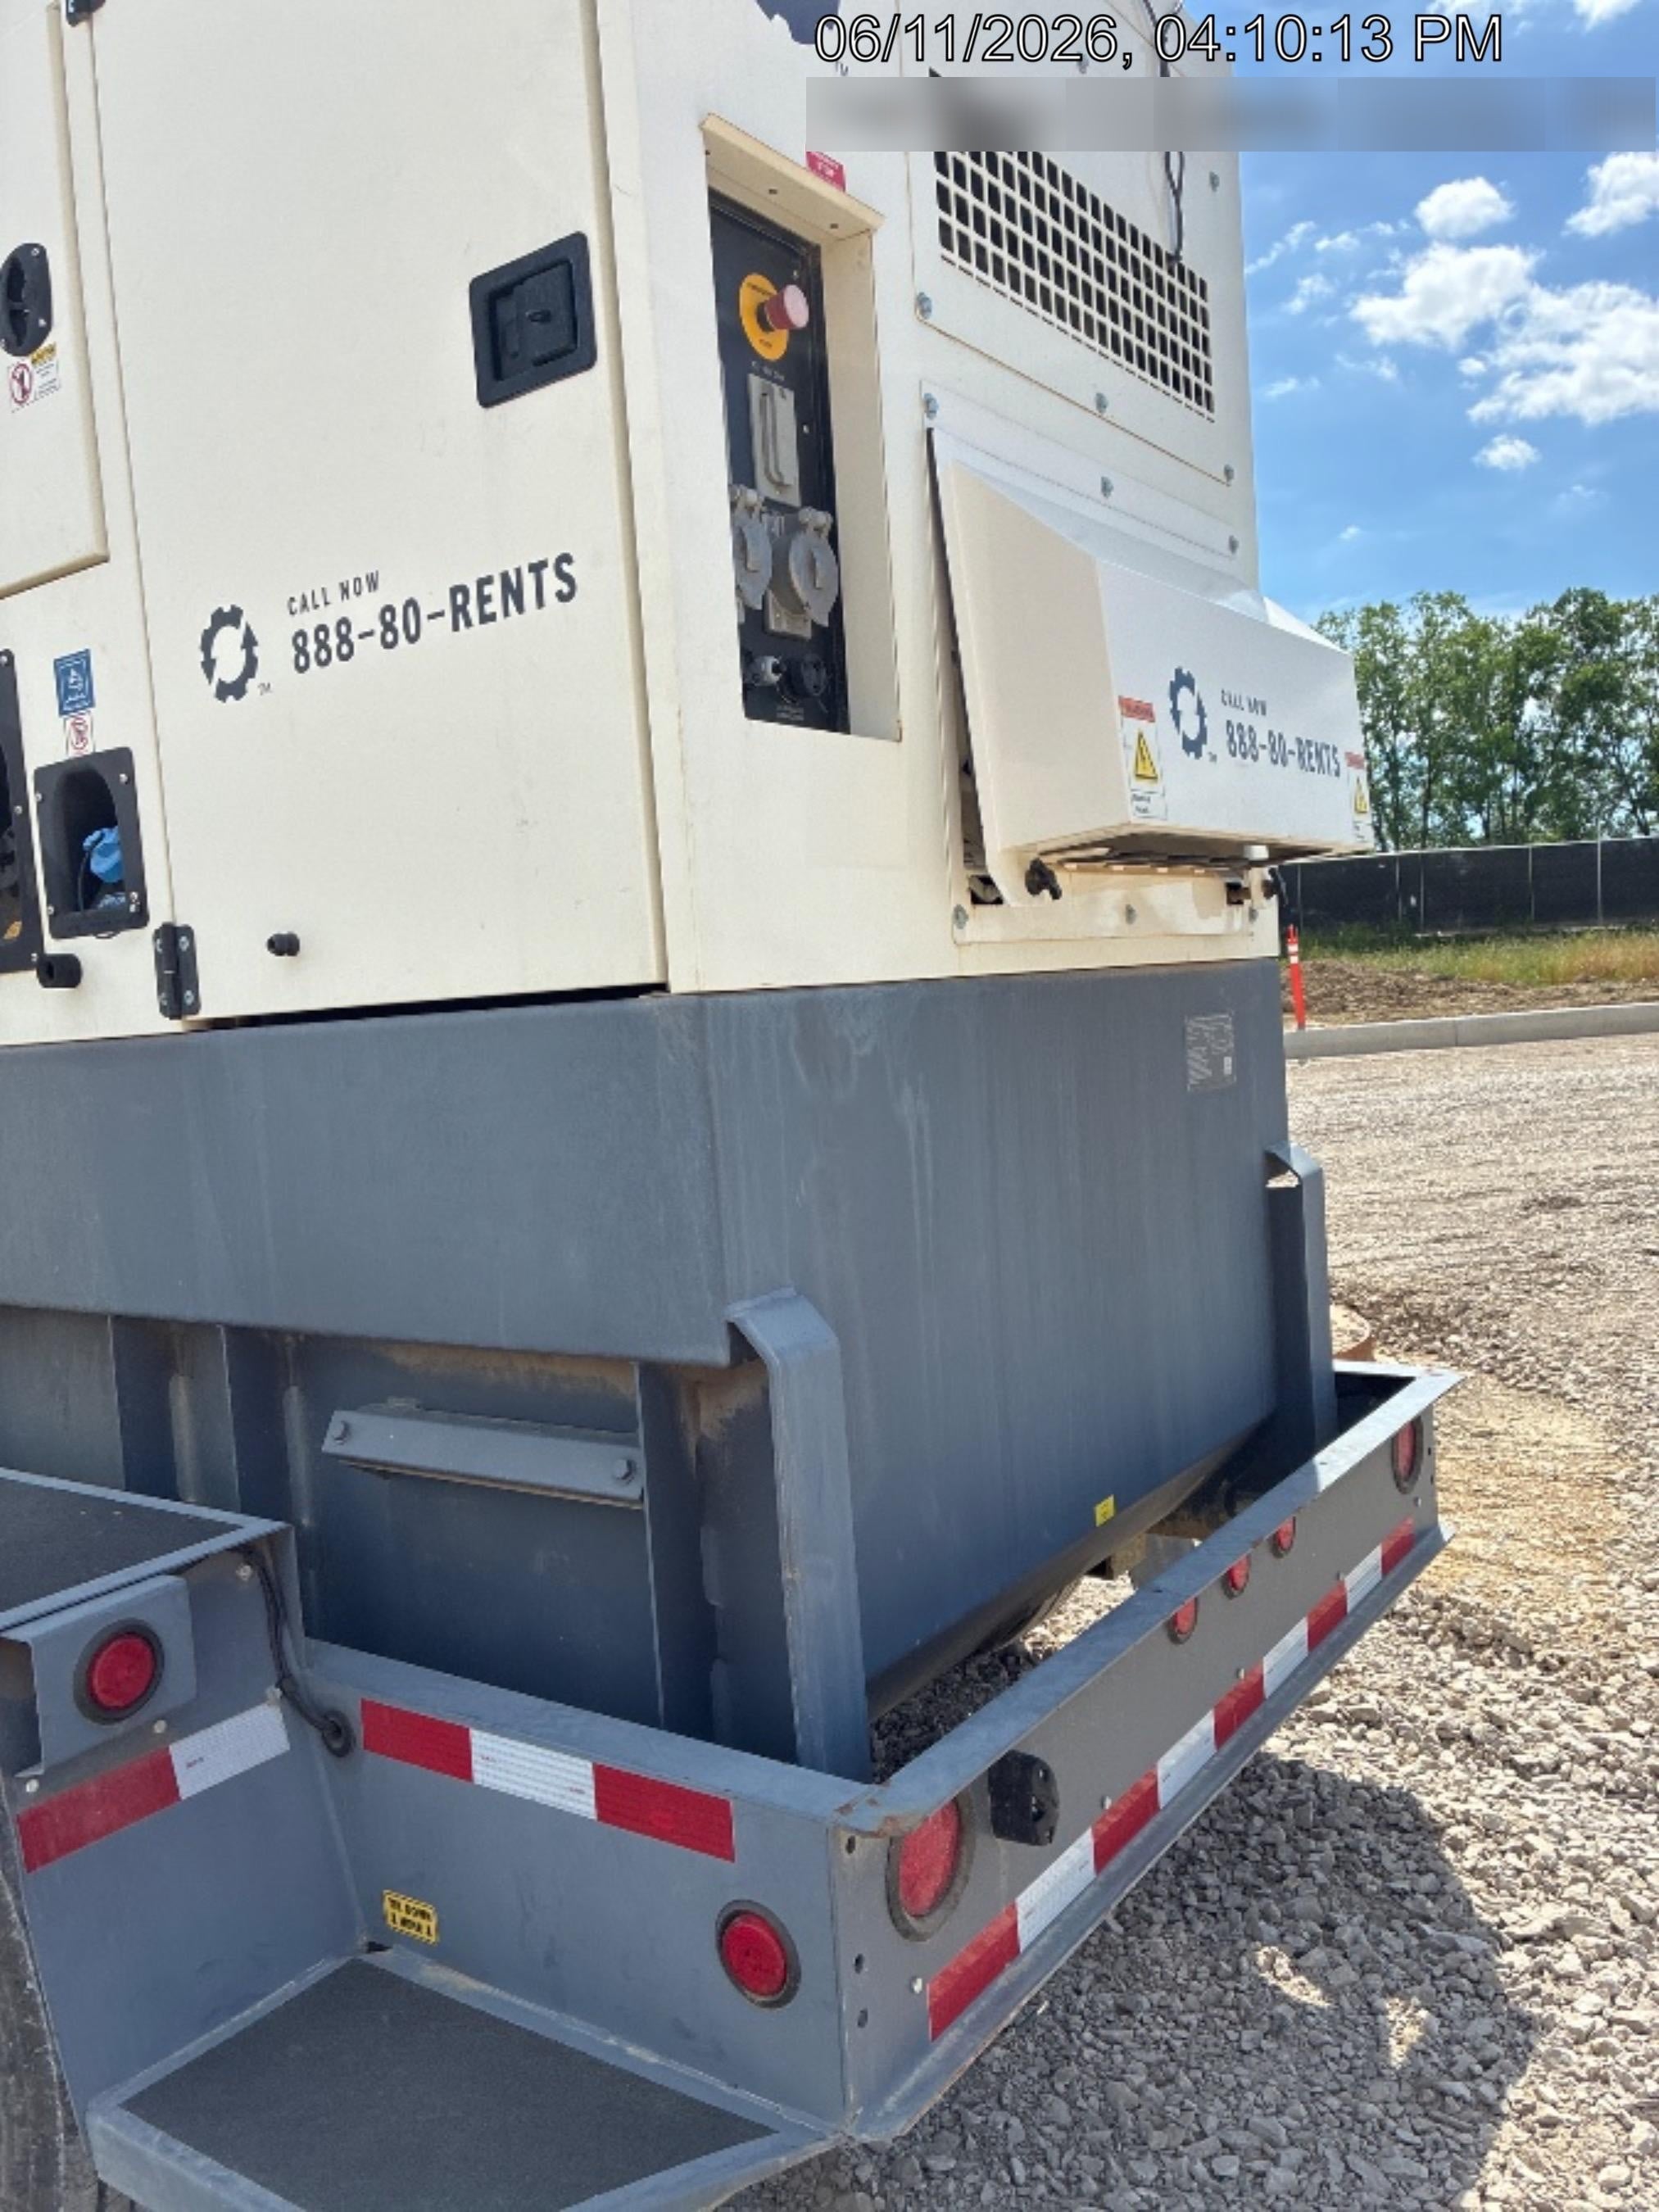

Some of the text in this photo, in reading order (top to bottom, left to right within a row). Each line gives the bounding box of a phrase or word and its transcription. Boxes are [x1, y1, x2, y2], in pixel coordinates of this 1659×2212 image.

[287, 570, 380, 616] CALL NOW
[290, 551, 578, 675] 888-80-RENTS
[1226, 718, 1341, 778] 888-80-RENTS
